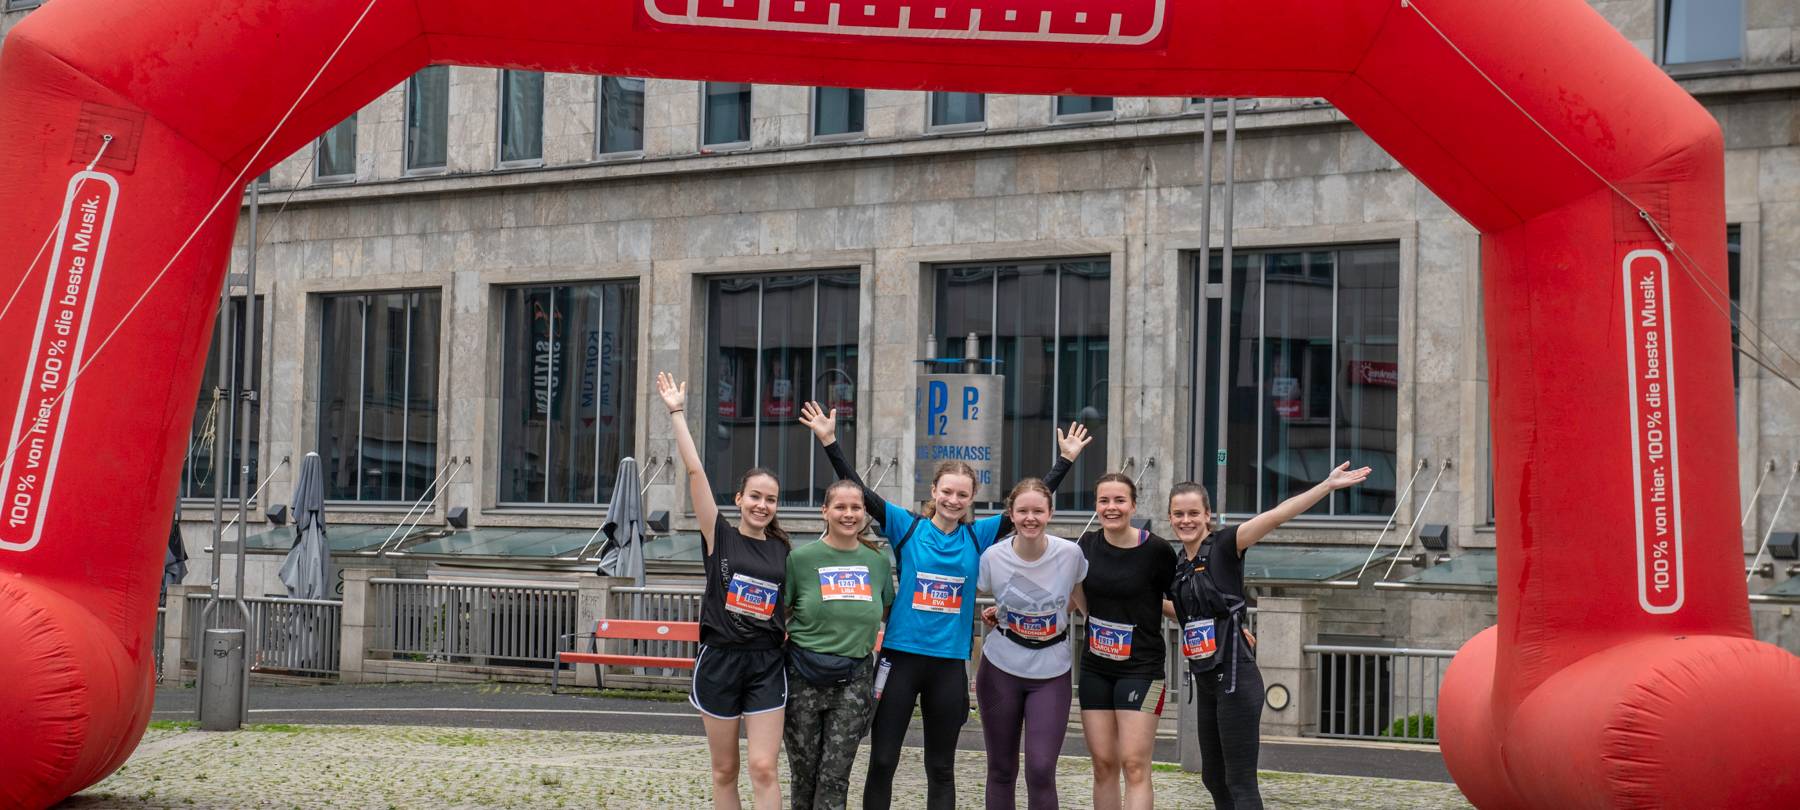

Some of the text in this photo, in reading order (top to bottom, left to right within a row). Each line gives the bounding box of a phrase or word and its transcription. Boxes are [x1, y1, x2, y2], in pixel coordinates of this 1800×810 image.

[9, 195, 100, 528] 100% von hier. 100% die beste Musik.
[932, 445, 991, 461] SPARKASSE
[1640, 271, 1669, 593] 100% von hier. 100% die beste Musik.
